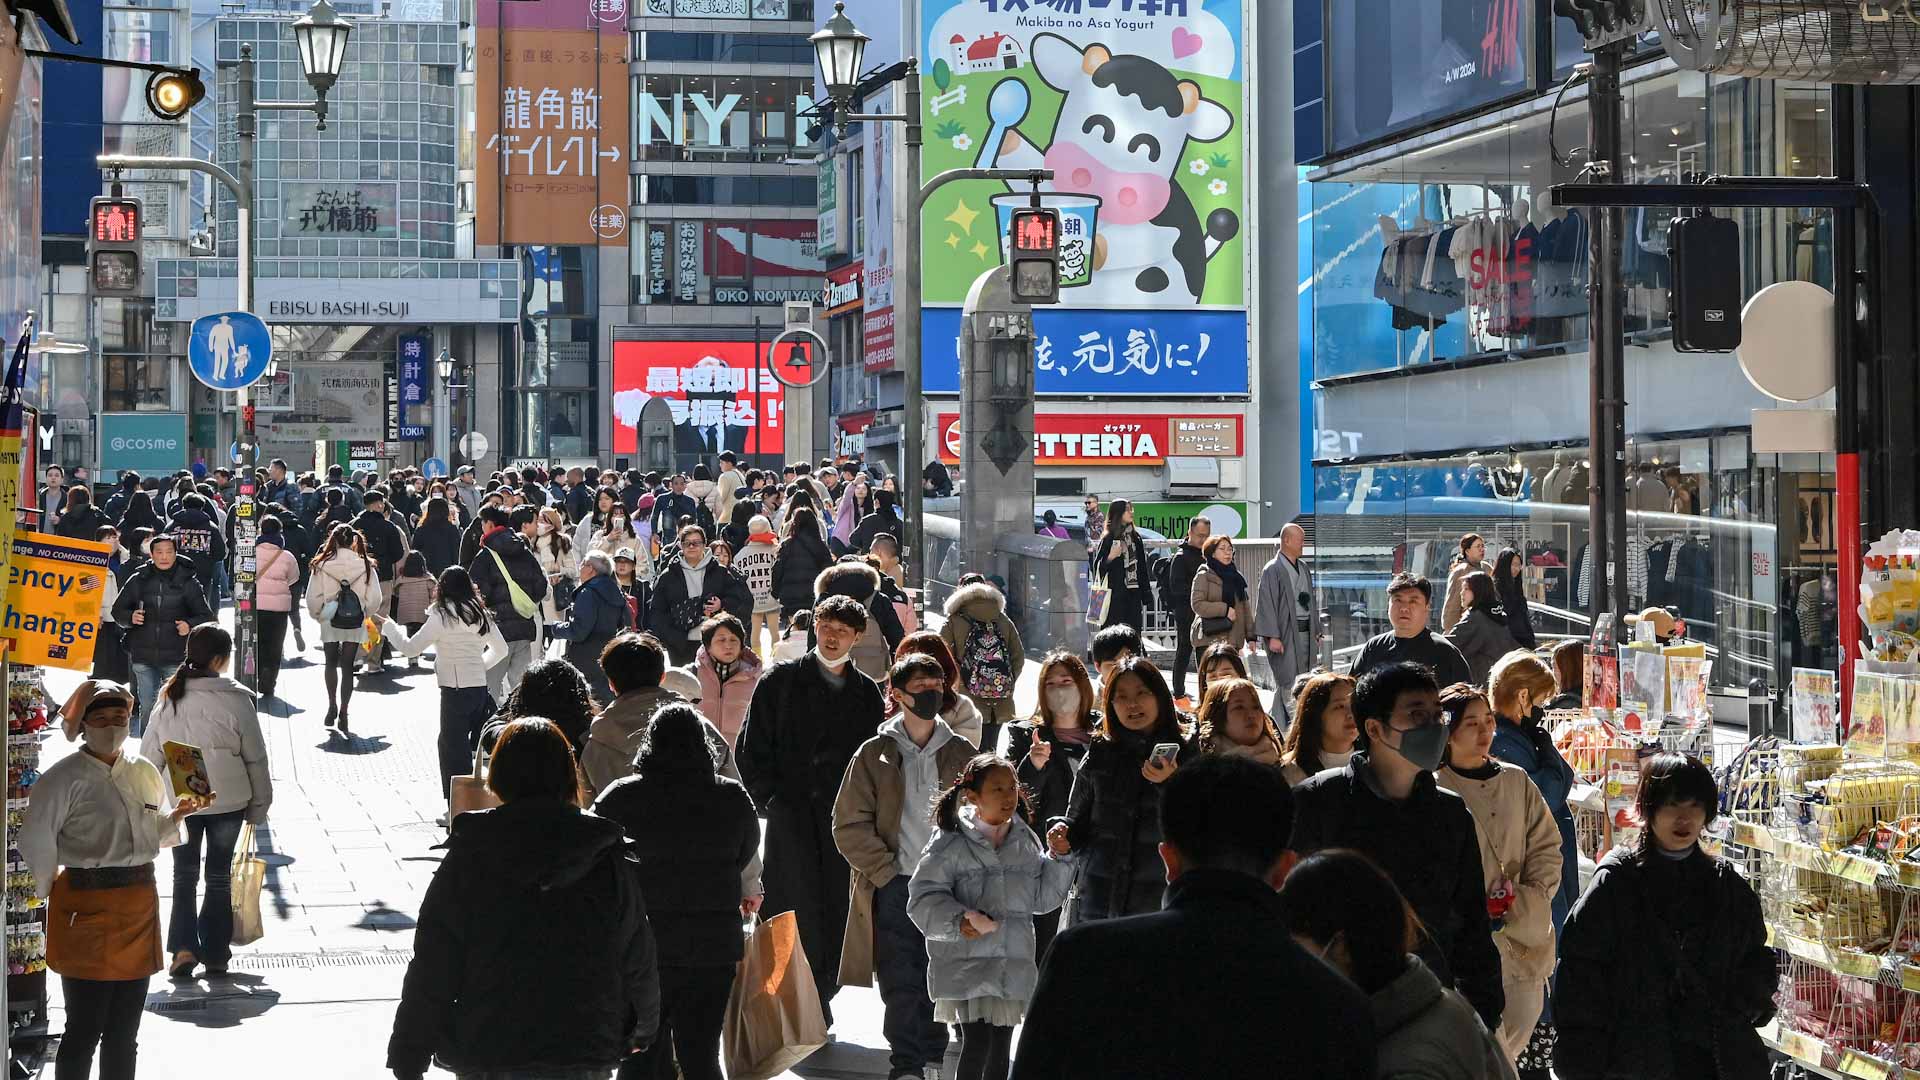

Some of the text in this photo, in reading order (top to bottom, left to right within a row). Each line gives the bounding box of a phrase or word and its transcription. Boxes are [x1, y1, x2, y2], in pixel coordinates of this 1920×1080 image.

[1016, 16, 1154, 31] Makiba no Asa Yogurt
[1459, 60, 1476, 79] 2024
[504, 87, 603, 129] 龍角散
[639, 92, 742, 146] NY
[486, 134, 621, 176] ダイレクト
[316, 190, 362, 206] なんば
[300, 205, 378, 233] 戎橋筋
[592, 214, 623, 228] 生薬
[1061, 218, 1081, 235] 朝
[649, 230, 666, 295] 焼きそば
[680, 222, 697, 300] お好み焼き
[1470, 238, 1532, 290] SALE
[717, 289, 824, 303] OKO NOMIYAK
[270, 301, 409, 318] EBISU BASHI-SUJI
[1036, 328, 1211, 377] を、元気に!
[404, 341, 422, 400] 時計倉
[401, 427, 425, 437] TOKIA
[1104, 424, 1142, 433] ゼッテリア
[1179, 422, 1230, 431] 絶品バーガー
[111, 437, 177, 451] @cosme
[1196, 443, 1230, 451] コーヒー
[38, 549, 51, 557] NO
[52, 551, 107, 565] COMMISSION
[738, 553, 777, 569] BROOKLY
[1753, 564, 1769, 576] SALE
[751, 580, 771, 589] NYC
[4, 604, 94, 645] hange
